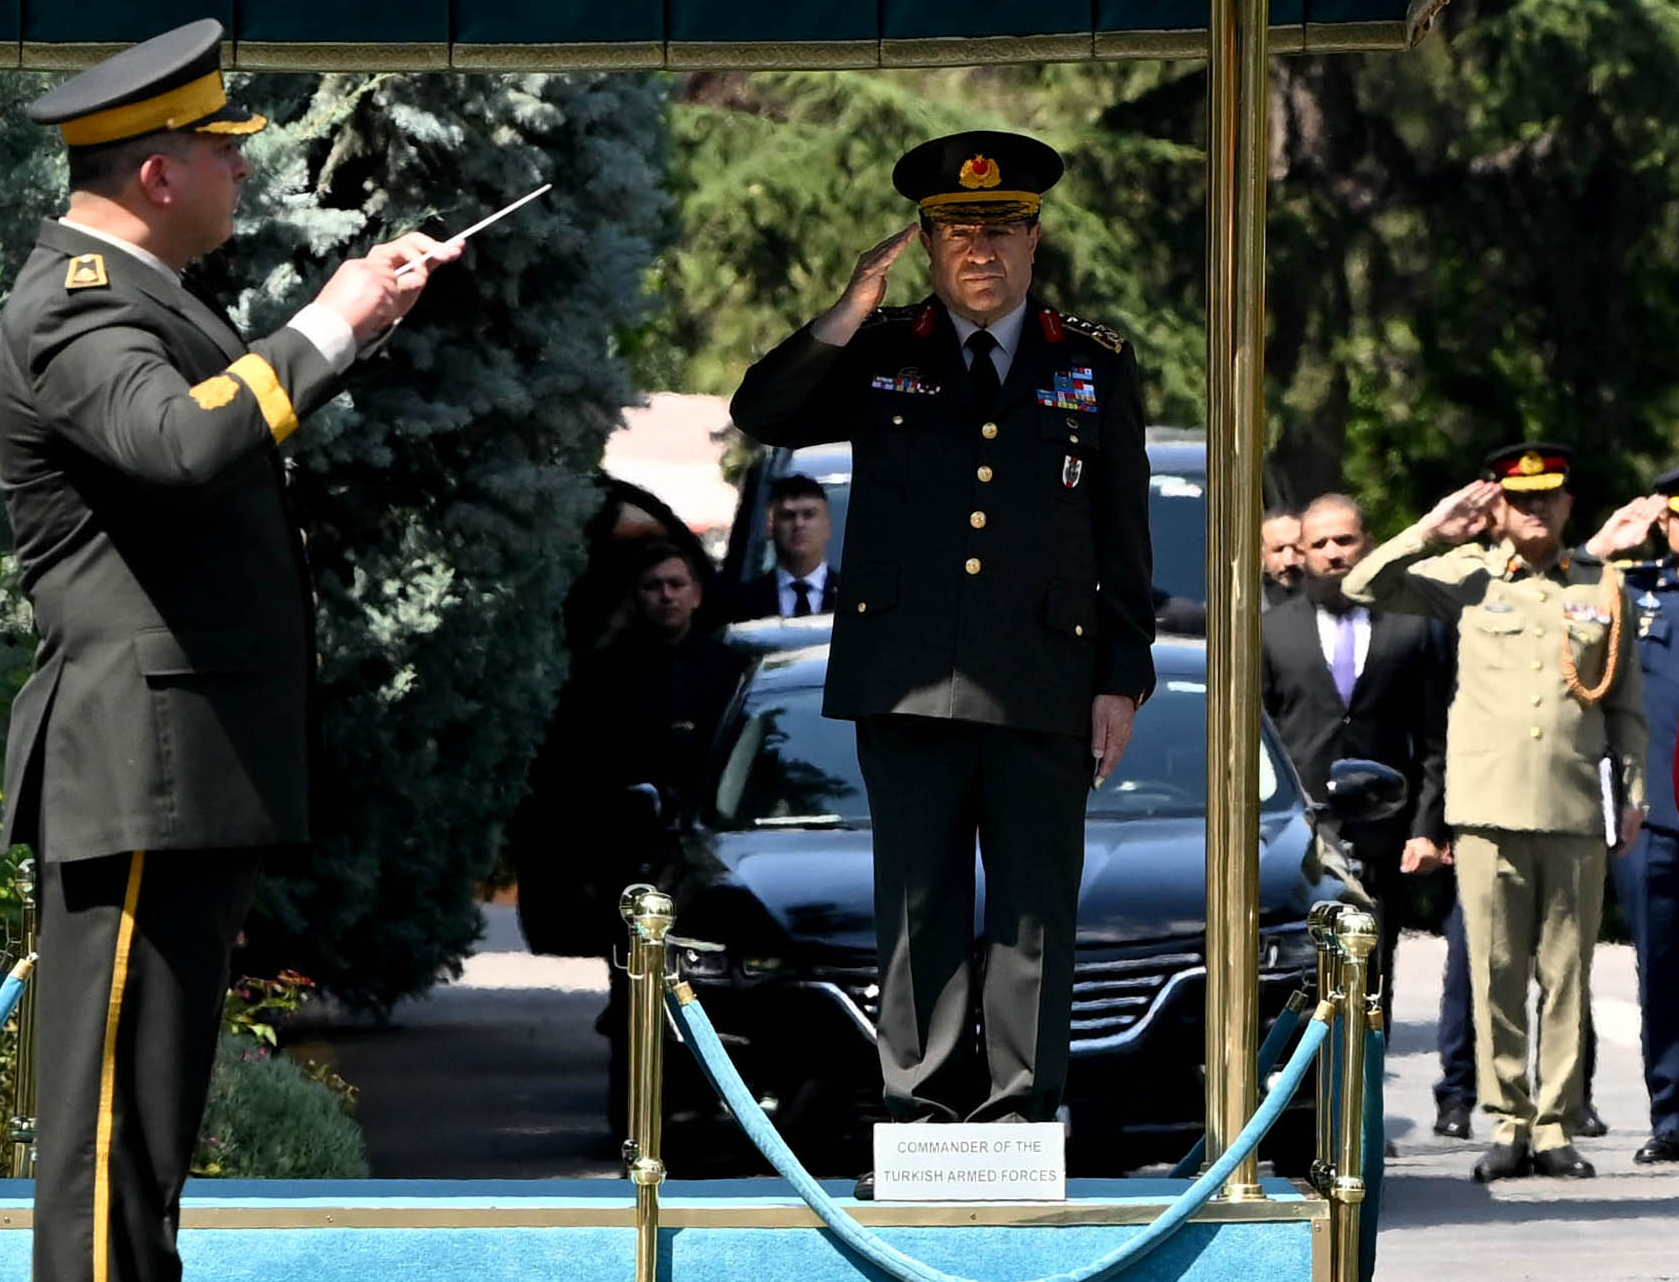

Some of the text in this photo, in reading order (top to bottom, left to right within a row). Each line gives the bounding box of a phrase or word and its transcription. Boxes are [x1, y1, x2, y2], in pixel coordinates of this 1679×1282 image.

[897, 1141, 1042, 1153] COMMANDER OF THE
[884, 1169, 1057, 1183] TURKISH ARMED FORCES
